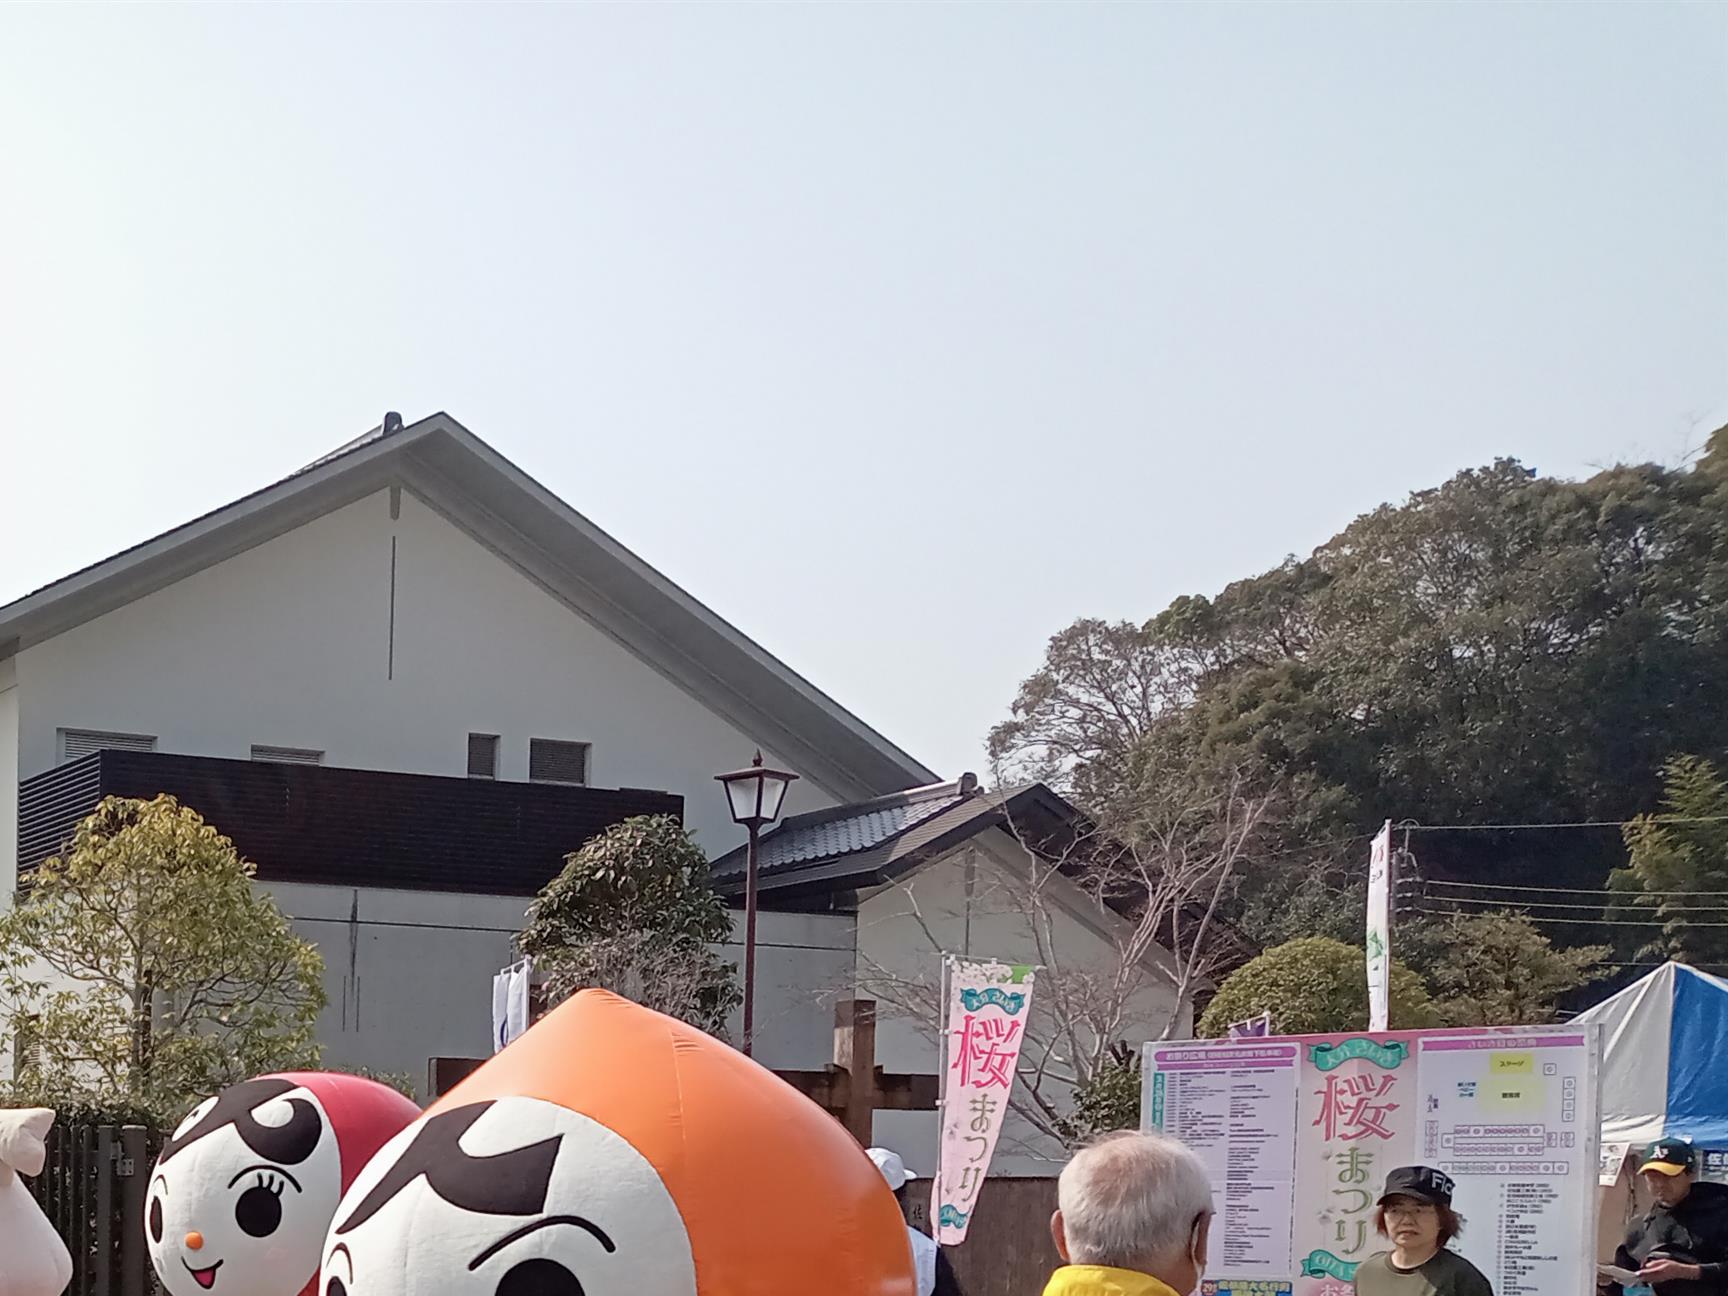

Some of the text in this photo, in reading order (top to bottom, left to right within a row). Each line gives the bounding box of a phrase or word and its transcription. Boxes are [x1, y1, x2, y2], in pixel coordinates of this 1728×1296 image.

[951, 1015, 1022, 1202] 桜まつり
[1312, 1073, 1400, 1255] 桜まつり
